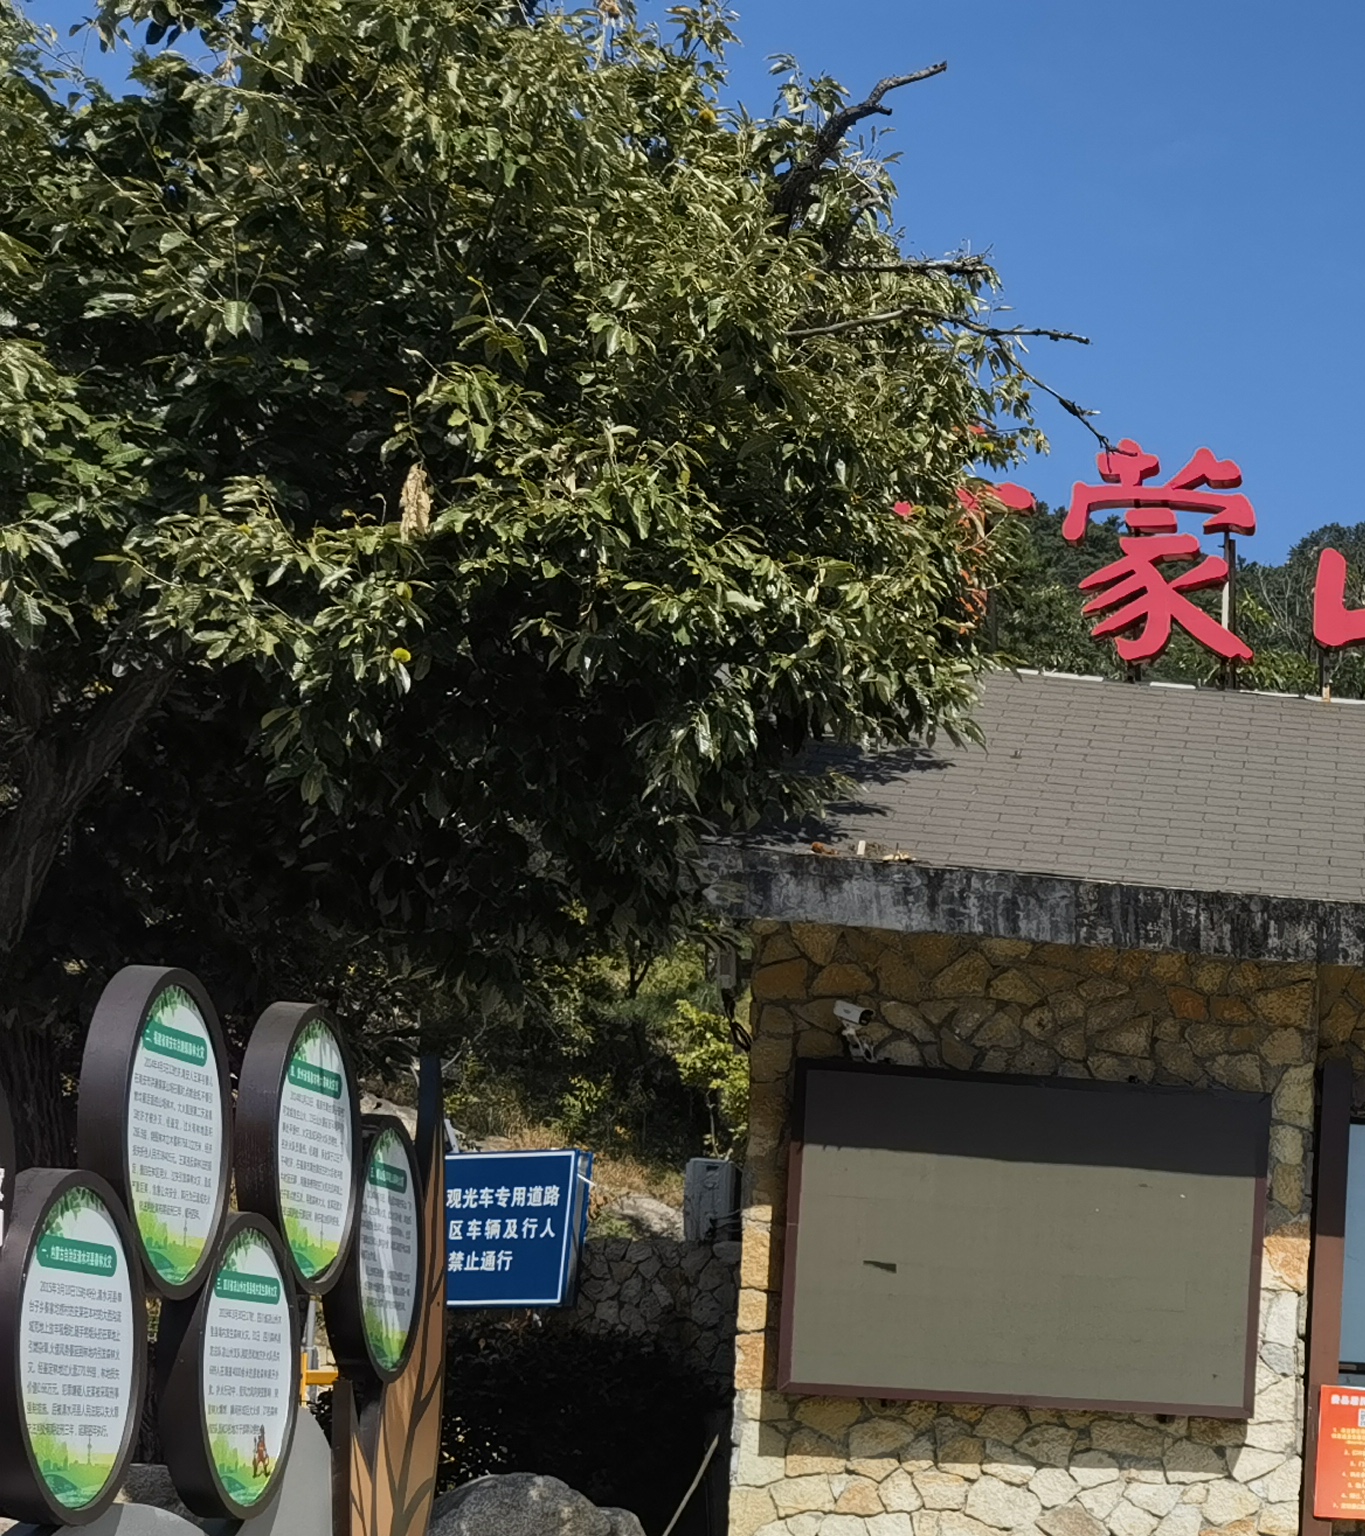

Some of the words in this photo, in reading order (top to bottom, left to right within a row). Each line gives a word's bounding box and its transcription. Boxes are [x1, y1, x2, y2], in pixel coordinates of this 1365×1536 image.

[446, 1185, 560, 1209] 观光车专用道路
[448, 1217, 556, 1240] 区车辆及行人
[447, 1250, 513, 1272] 禁止通行
